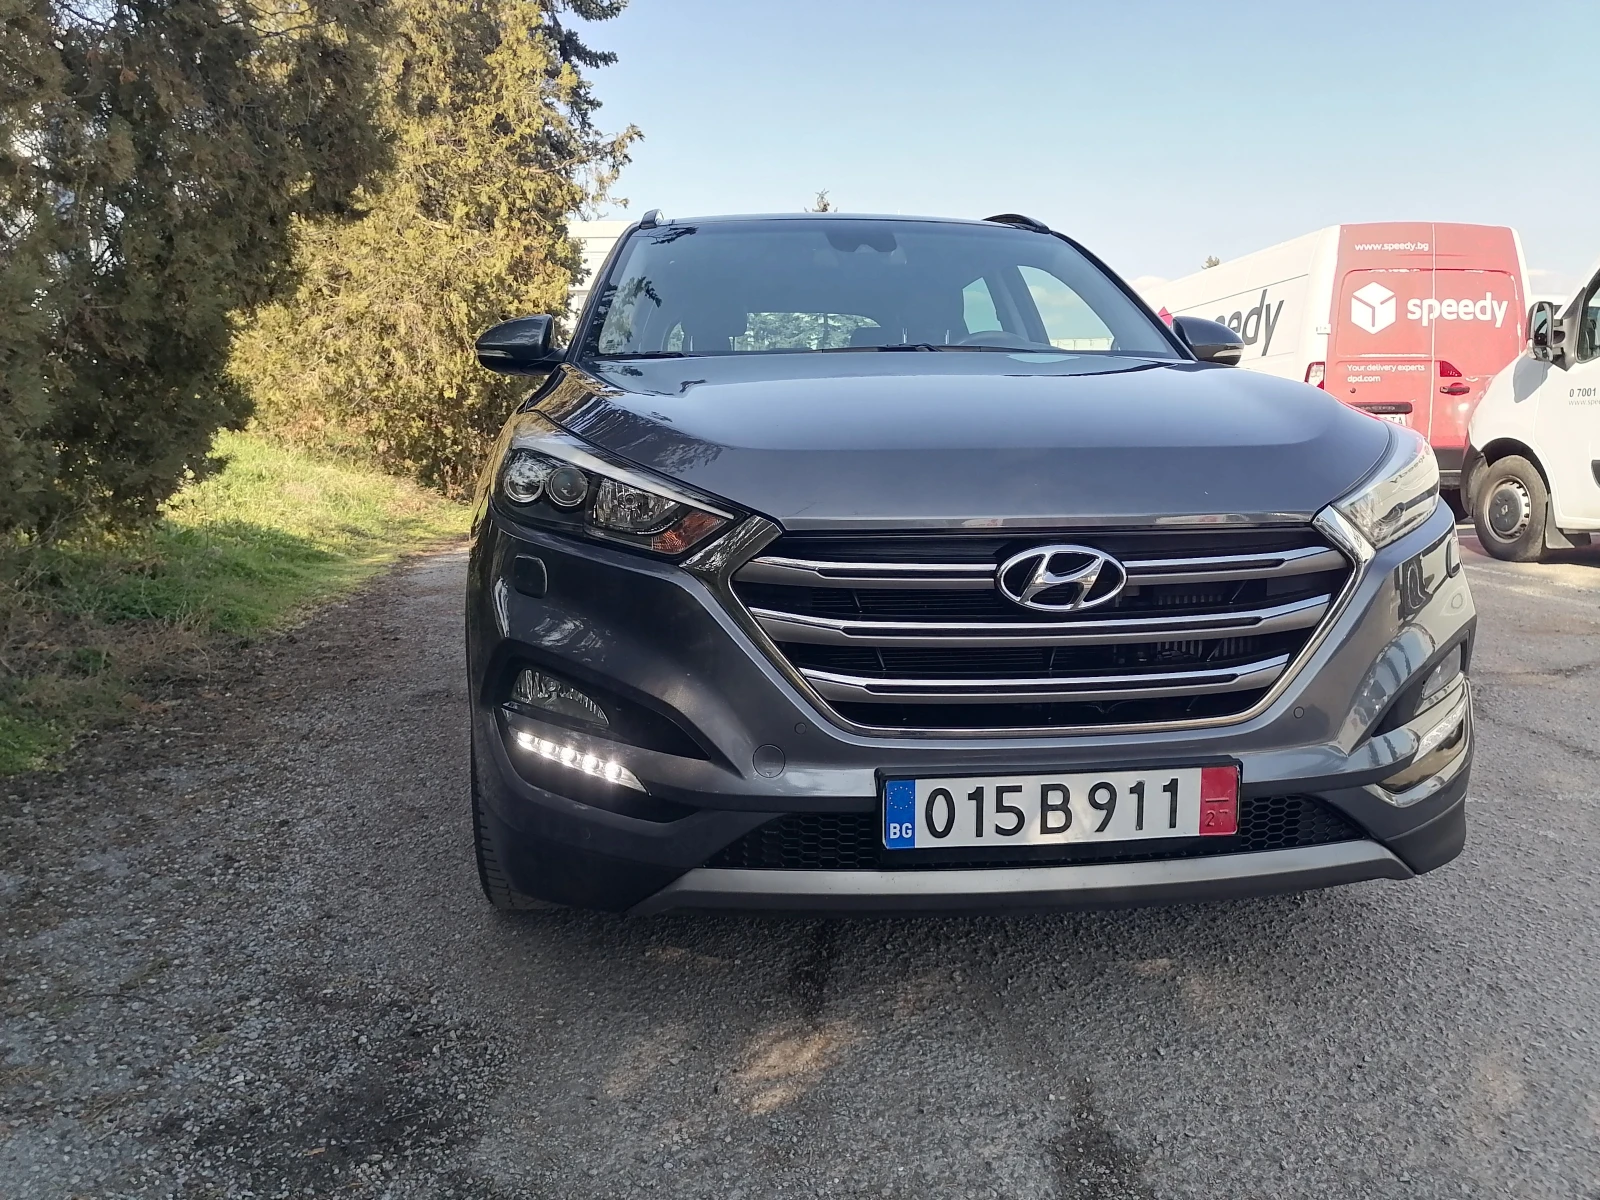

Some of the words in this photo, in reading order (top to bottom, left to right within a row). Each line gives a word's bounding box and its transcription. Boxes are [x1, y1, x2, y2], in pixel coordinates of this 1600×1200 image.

[1355, 241, 1429, 251] www.speedy.bg
[1407, 292, 1508, 328] speedy
[1347, 364, 1366, 372] Your
[1366, 363, 1397, 373] delivery
[1397, 364, 1425, 373] experts
[1347, 375, 1380, 383] dpd.com
[1569, 388, 1575, 398] 0
[1577, 387, 1597, 398] 7001
[889, 822, 913, 839] BG
